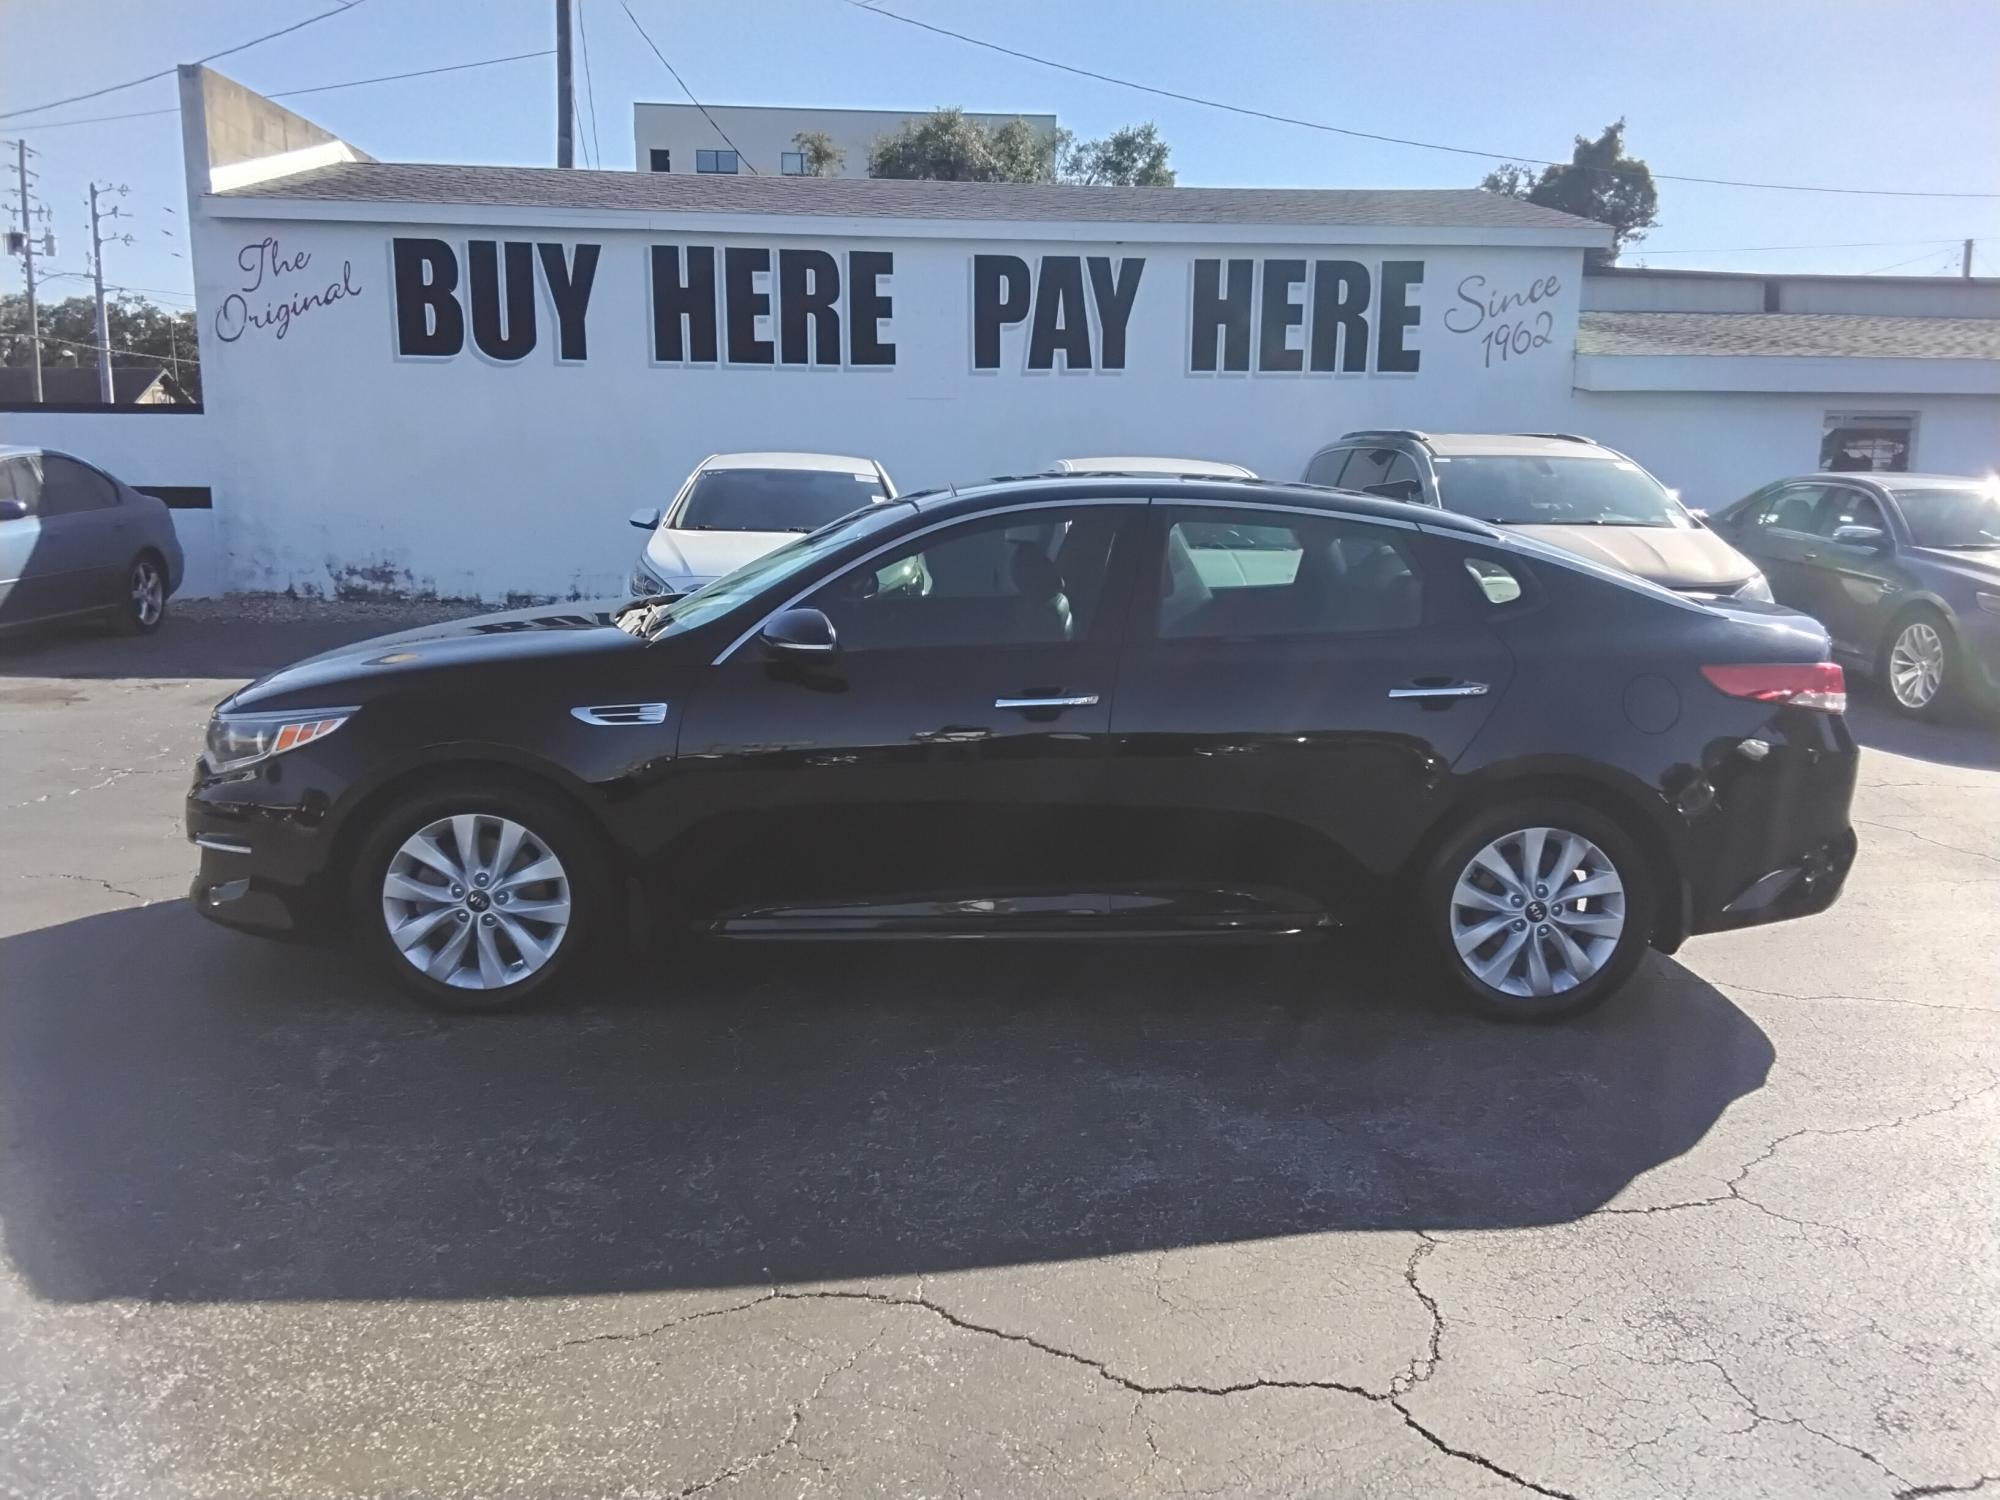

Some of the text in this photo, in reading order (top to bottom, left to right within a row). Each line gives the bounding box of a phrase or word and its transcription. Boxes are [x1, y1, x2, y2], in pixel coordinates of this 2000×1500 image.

[238, 237, 312, 292] The
[214, 261, 362, 343] Original
[391, 237, 1425, 373] BUY HERE PAY HERE
[1443, 274, 1561, 334] Since
[1481, 310, 1553, 369] 1962
[1529, 903, 1543, 921] KIA
